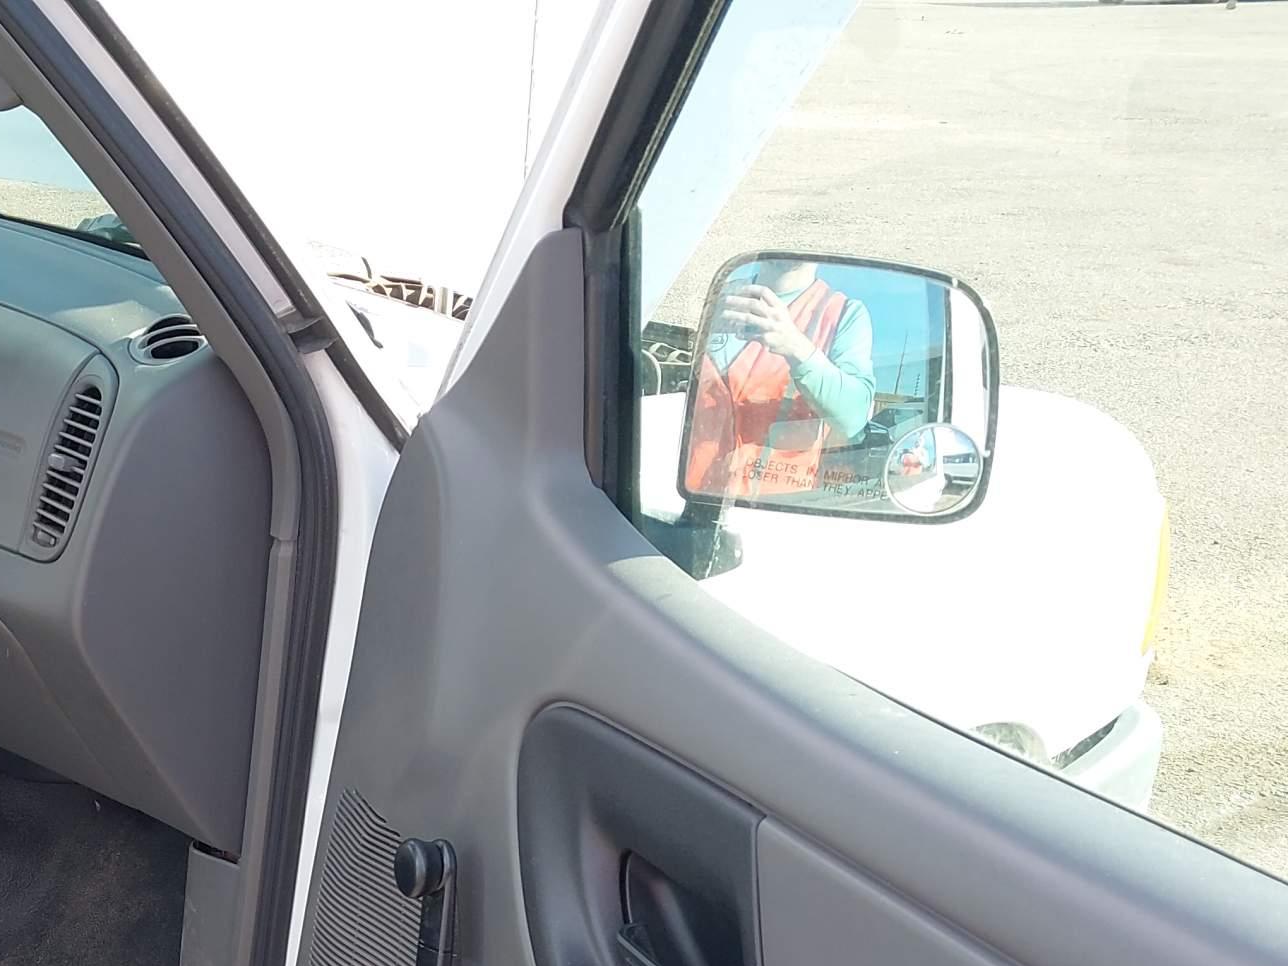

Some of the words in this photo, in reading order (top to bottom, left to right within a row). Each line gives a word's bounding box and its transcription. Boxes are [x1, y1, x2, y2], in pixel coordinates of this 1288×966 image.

[745, 457, 799, 474] OBJECTS
[805, 463, 819, 478] IN
[822, 469, 870, 486] MIRROR
[784, 475, 815, 489] THAN
[822, 480, 852, 497] THEY
[857, 488, 887, 502] APPE
